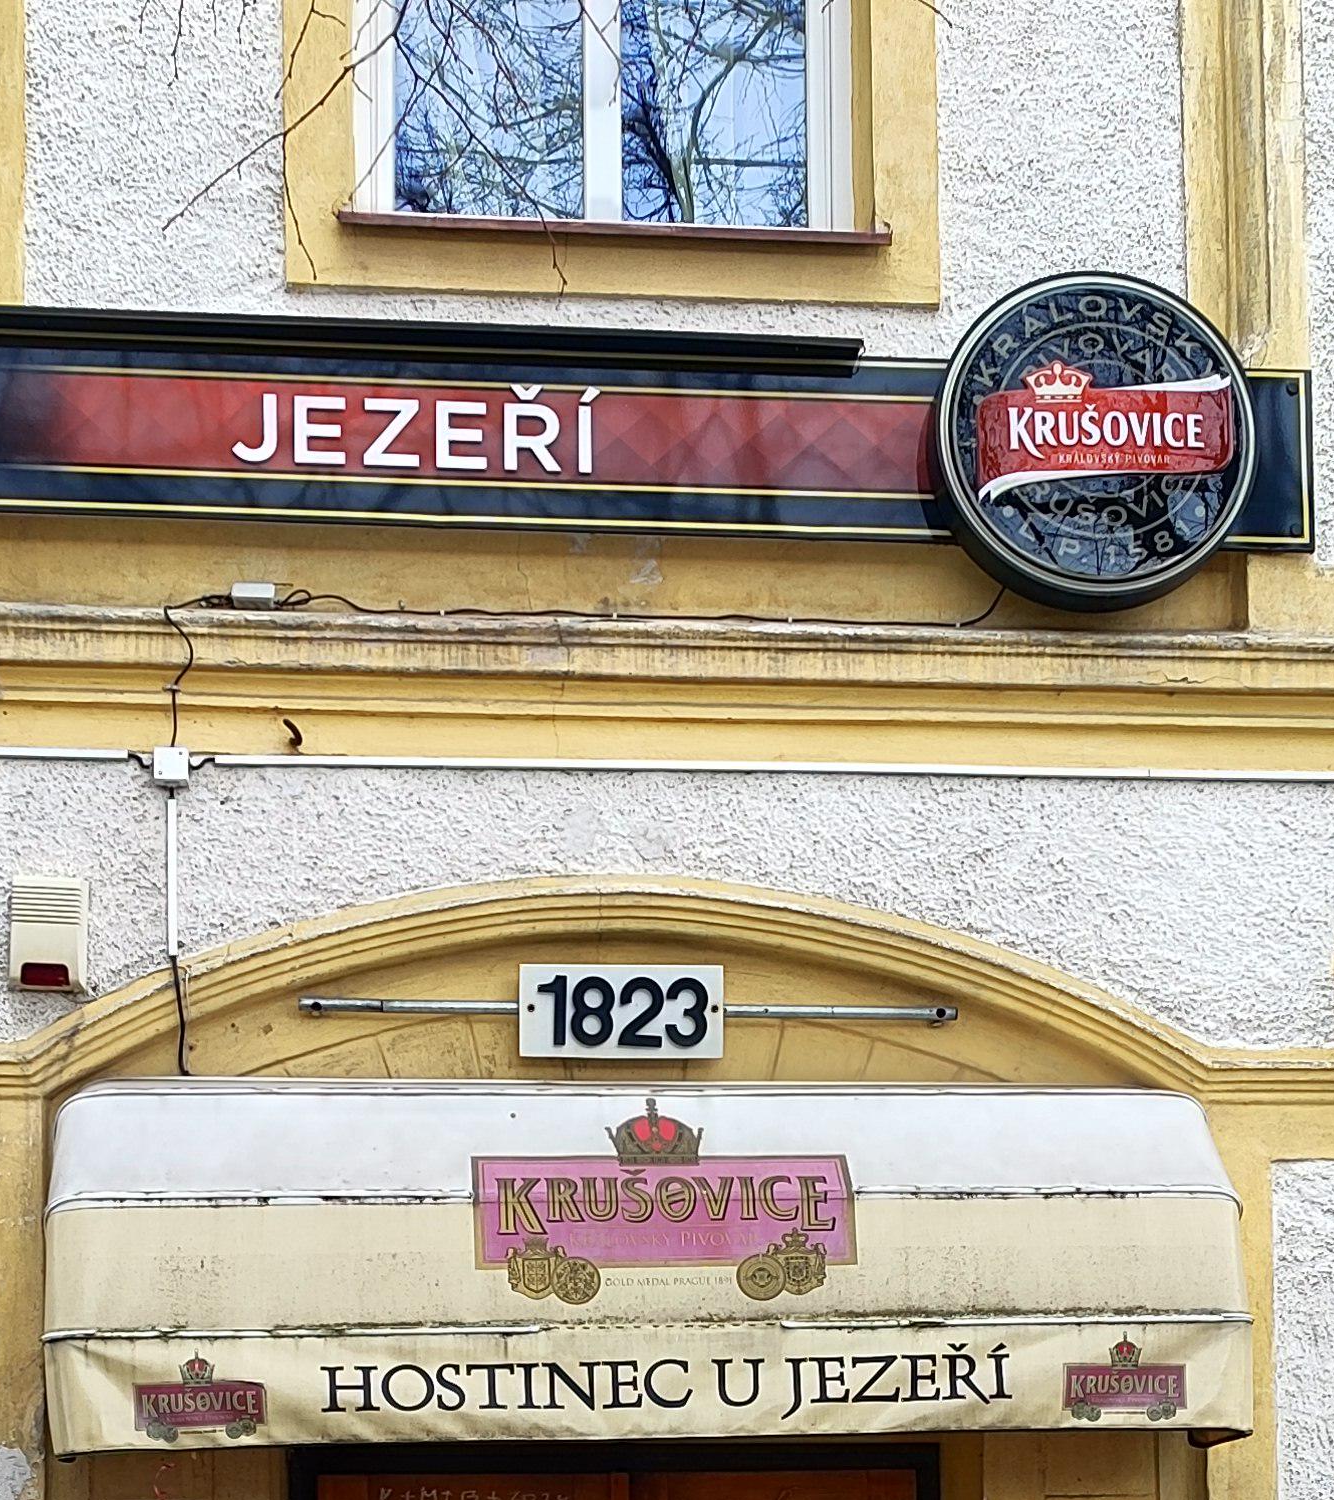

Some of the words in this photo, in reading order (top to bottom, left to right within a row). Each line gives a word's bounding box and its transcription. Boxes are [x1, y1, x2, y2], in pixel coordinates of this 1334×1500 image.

[231, 384, 601, 475] JEZEŘÍ
[1007, 404, 1205, 459] KRUŠOVICE
[537, 975, 709, 1048] 1823
[496, 1169, 836, 1235] KRUŠOVICE
[605, 1277, 634, 1287] GOLD
[673, 1277, 710, 1287] PRAGUE
[141, 1388, 259, 1419] KRUŠOVICE
[319, 1358, 693, 1414] HOSTINEC
[710, 1357, 765, 1407] U
[780, 1342, 1013, 1420] JEZEŘÍ
[1070, 1371, 1180, 1398] KRUŠOVICE
